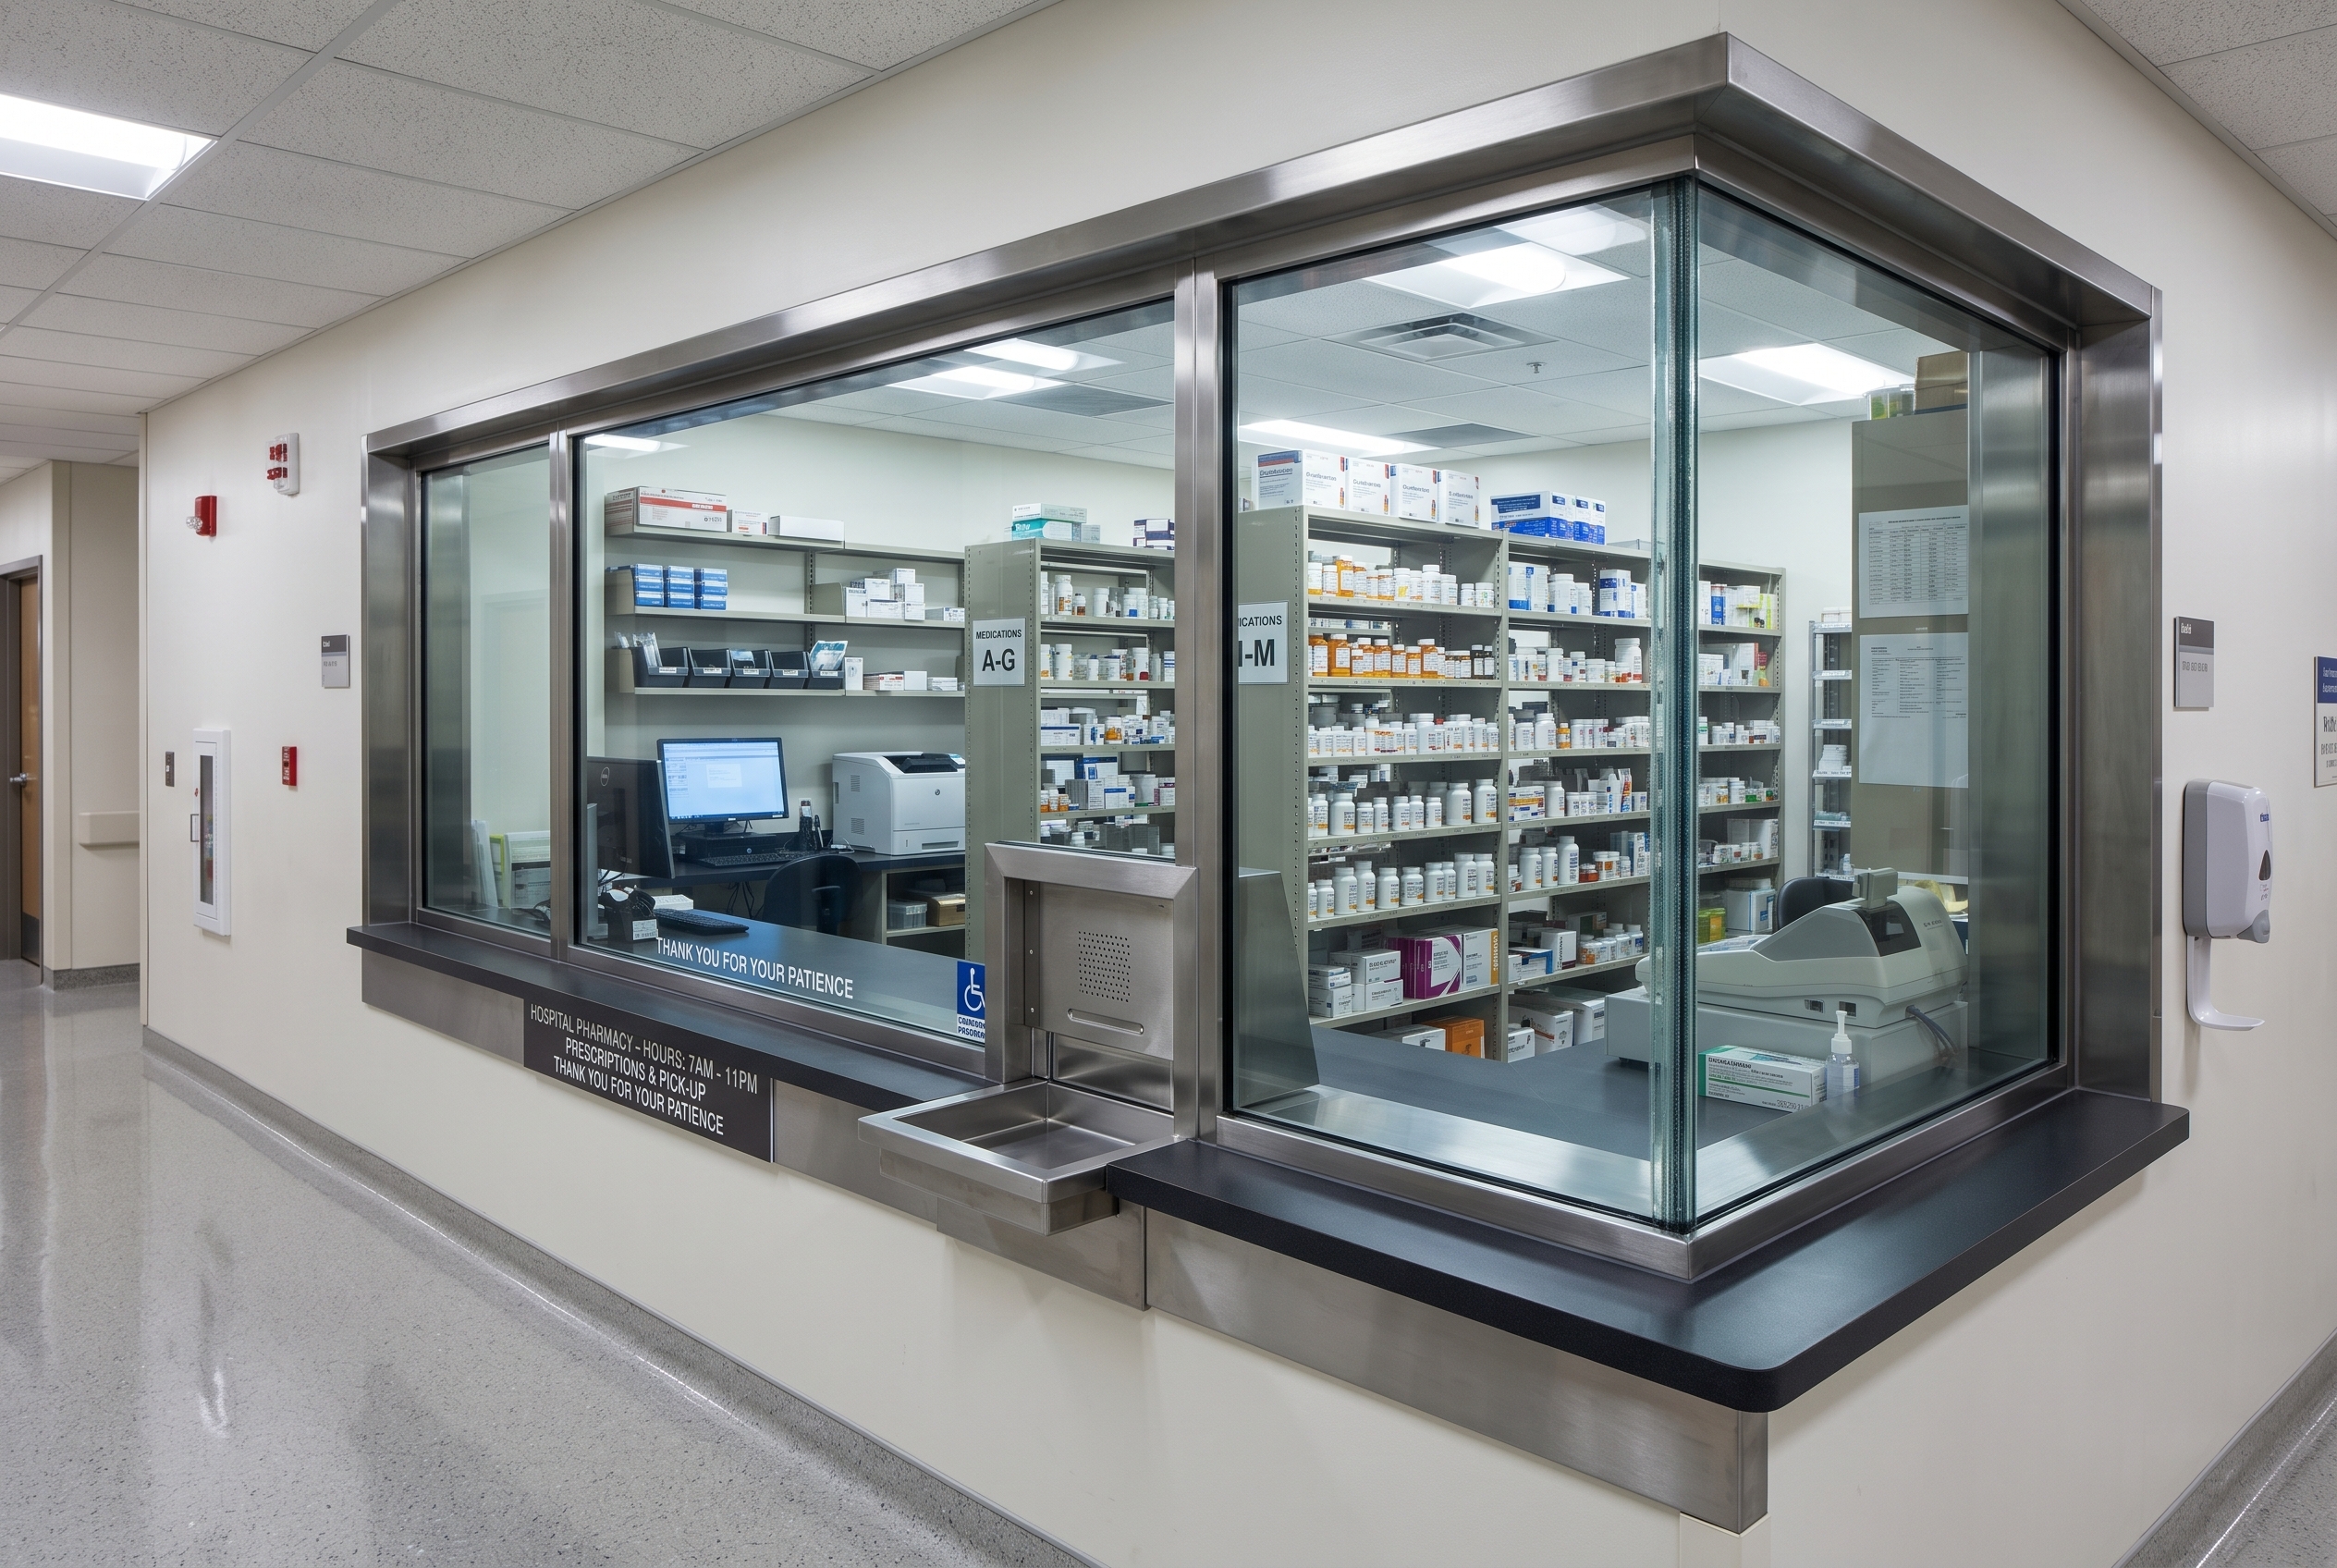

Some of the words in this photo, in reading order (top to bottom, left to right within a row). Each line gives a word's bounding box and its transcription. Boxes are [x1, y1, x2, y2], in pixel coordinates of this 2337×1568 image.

[975, 629, 1022, 640] MEDICATIONS
[1238, 615, 1282, 627] ICATIONS
[982, 648, 1015, 672] A-G
[655, 937, 693, 962] THANK
[695, 945, 720, 968] YOU
[723, 952, 747, 974] FOR
[750, 957, 785, 984] YOUR
[788, 966, 854, 999] PATIENCE
[531, 1003, 574, 1034] HOSPITAL
[576, 1018, 633, 1053] PHARMACY
[643, 1039, 686, 1071] HOURS:
[689, 1054, 714, 1080] 7AM
[725, 1066, 758, 1095] 11PM
[566, 1037, 646, 1082] PRESCRIPTIONS
[648, 1065, 657, 1086] &
[659, 1069, 706, 1102] PICK-UP
[554, 1055, 586, 1084] THANK
[588, 1068, 608, 1092] YOU
[610, 1078, 632, 1101] FOR
[634, 1085, 665, 1113] YOUR
[667, 1096, 724, 1136] PATIENCE
